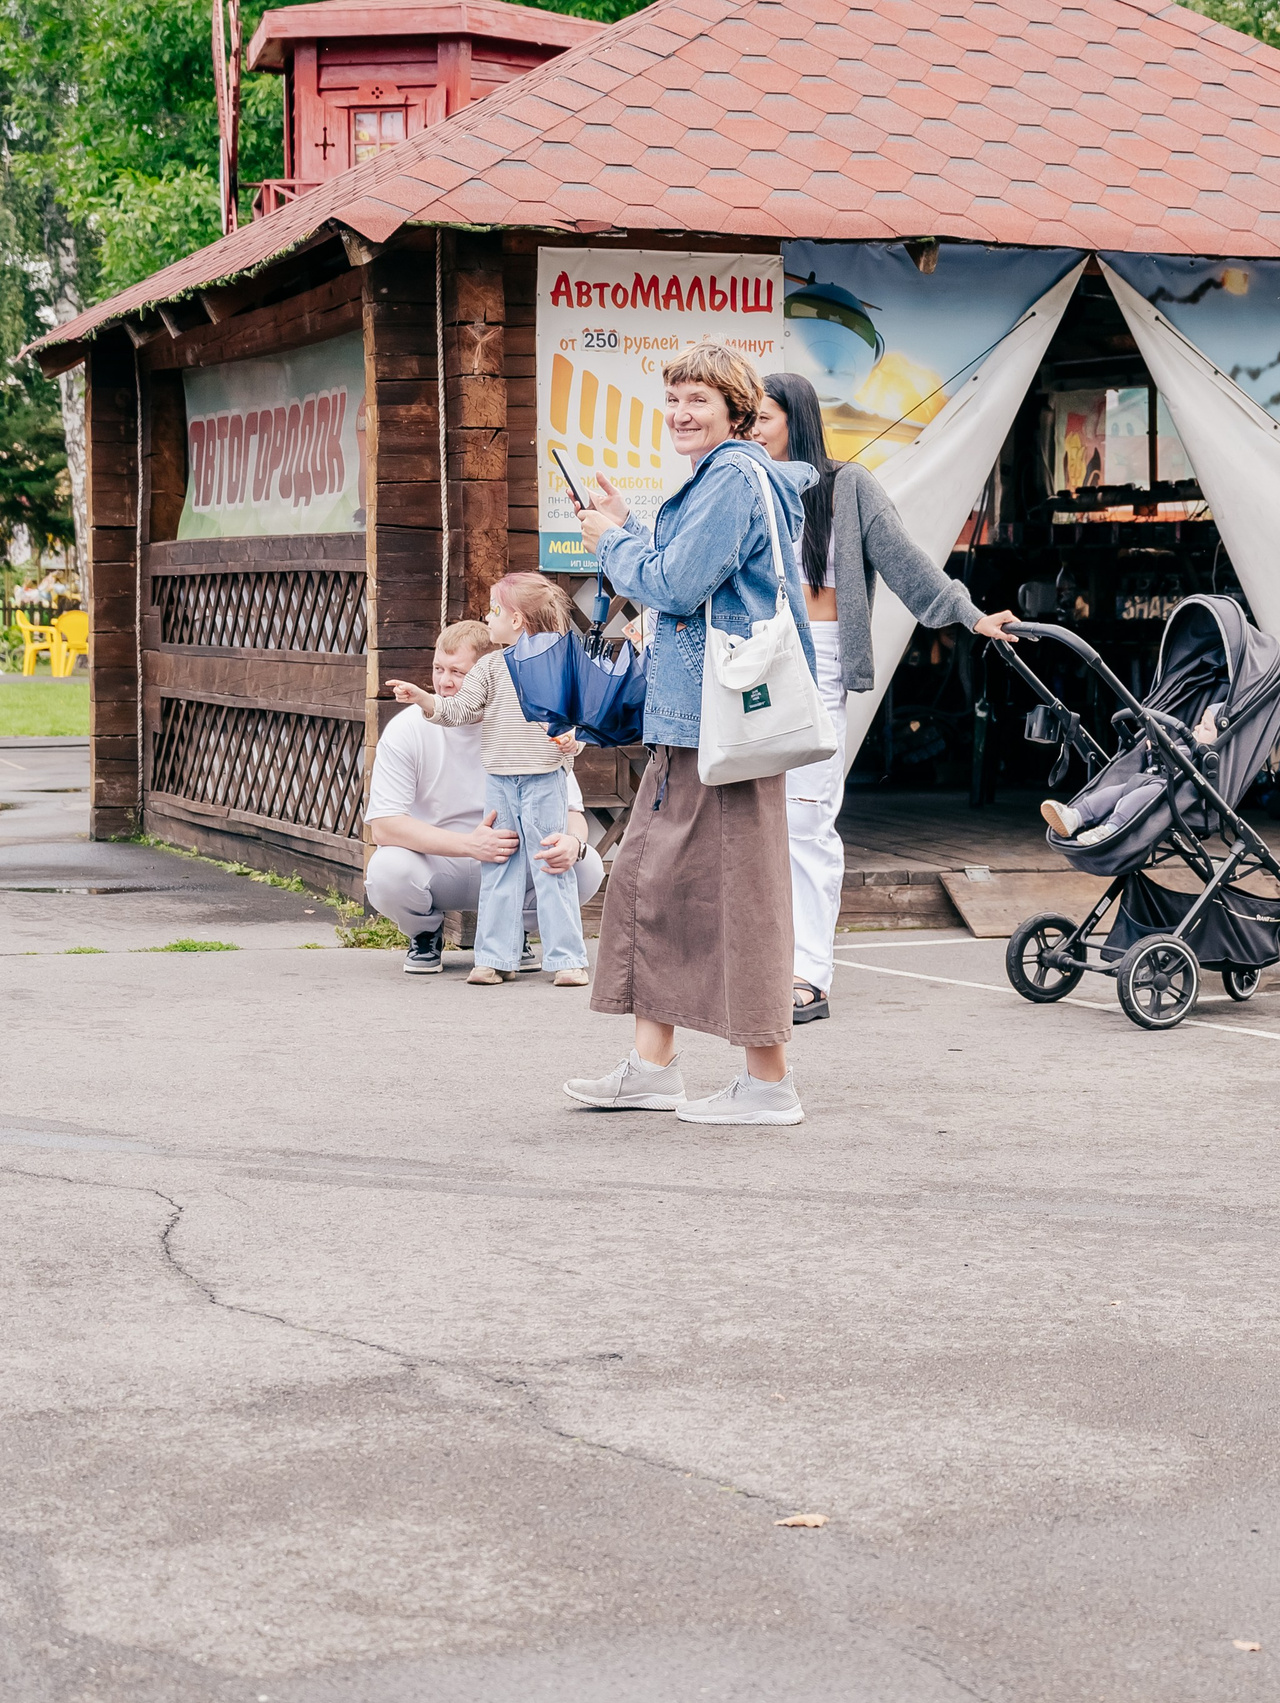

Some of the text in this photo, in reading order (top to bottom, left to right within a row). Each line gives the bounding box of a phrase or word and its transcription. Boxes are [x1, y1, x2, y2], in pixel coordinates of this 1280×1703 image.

[559, 338, 577, 351] от
[584, 332, 618, 348] 250
[623, 334, 679, 355] рублей
[634, 496, 664, 505] 22-00
